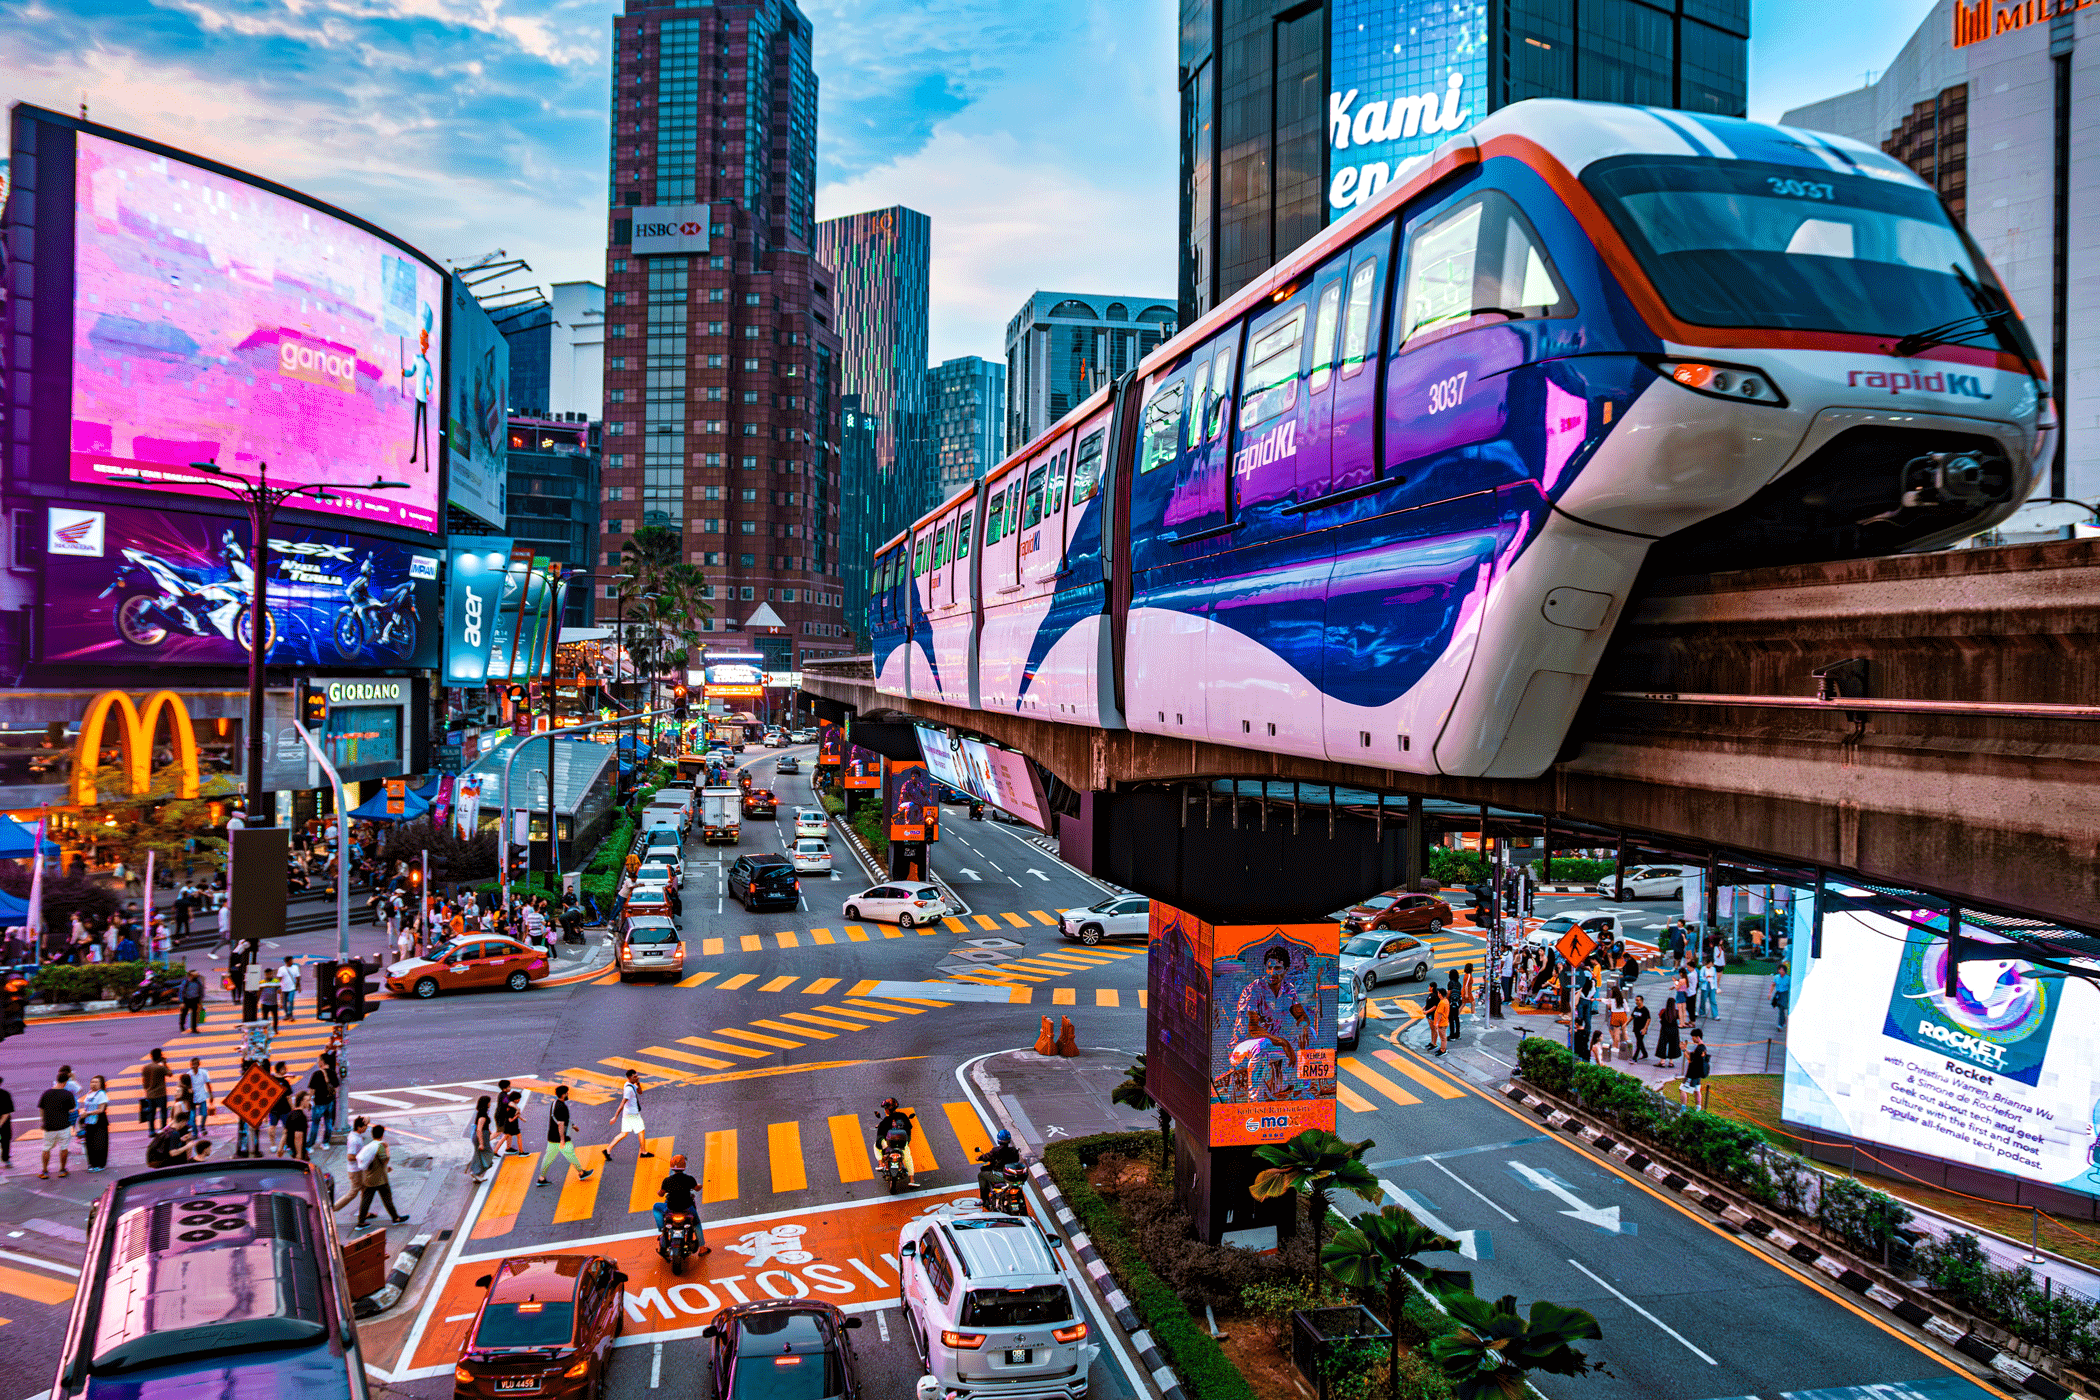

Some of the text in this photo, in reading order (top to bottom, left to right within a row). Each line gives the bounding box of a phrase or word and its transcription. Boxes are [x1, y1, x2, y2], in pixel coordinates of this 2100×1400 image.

[1995, 0, 2100, 35] MILL
[1330, 72, 1467, 149] Kami
[1329, 156, 1426, 209] en
[1767, 177, 1834, 200] 3037
[636, 222, 678, 237] HSBC
[281, 342, 355, 380] ganad
[1428, 371, 1469, 415] 3037
[1848, 369, 1994, 400] rapidKL
[1232, 419, 1297, 481] rapidKL
[54, 542, 96, 551] HONDA
[267, 538, 355, 563] RSX
[464, 585, 482, 648] acer
[329, 682, 400, 703] GIORDANO
[1918, 1020, 2007, 1060] ROCKET
[1303, 1064, 1330, 1077] RM59
[1884, 1055, 2054, 1121] with Christina Warren, Brianna Wu
[1945, 1060, 1994, 1086] Rocket
[1890, 1082, 2045, 1144] Geek out about tech and geek
[1907, 1075, 2023, 1123] & Simone de Rochefort
[1880, 1104, 2043, 1170] popular all-female tech podcast.
[1890, 1095, 2040, 1156] culture with the first and most
